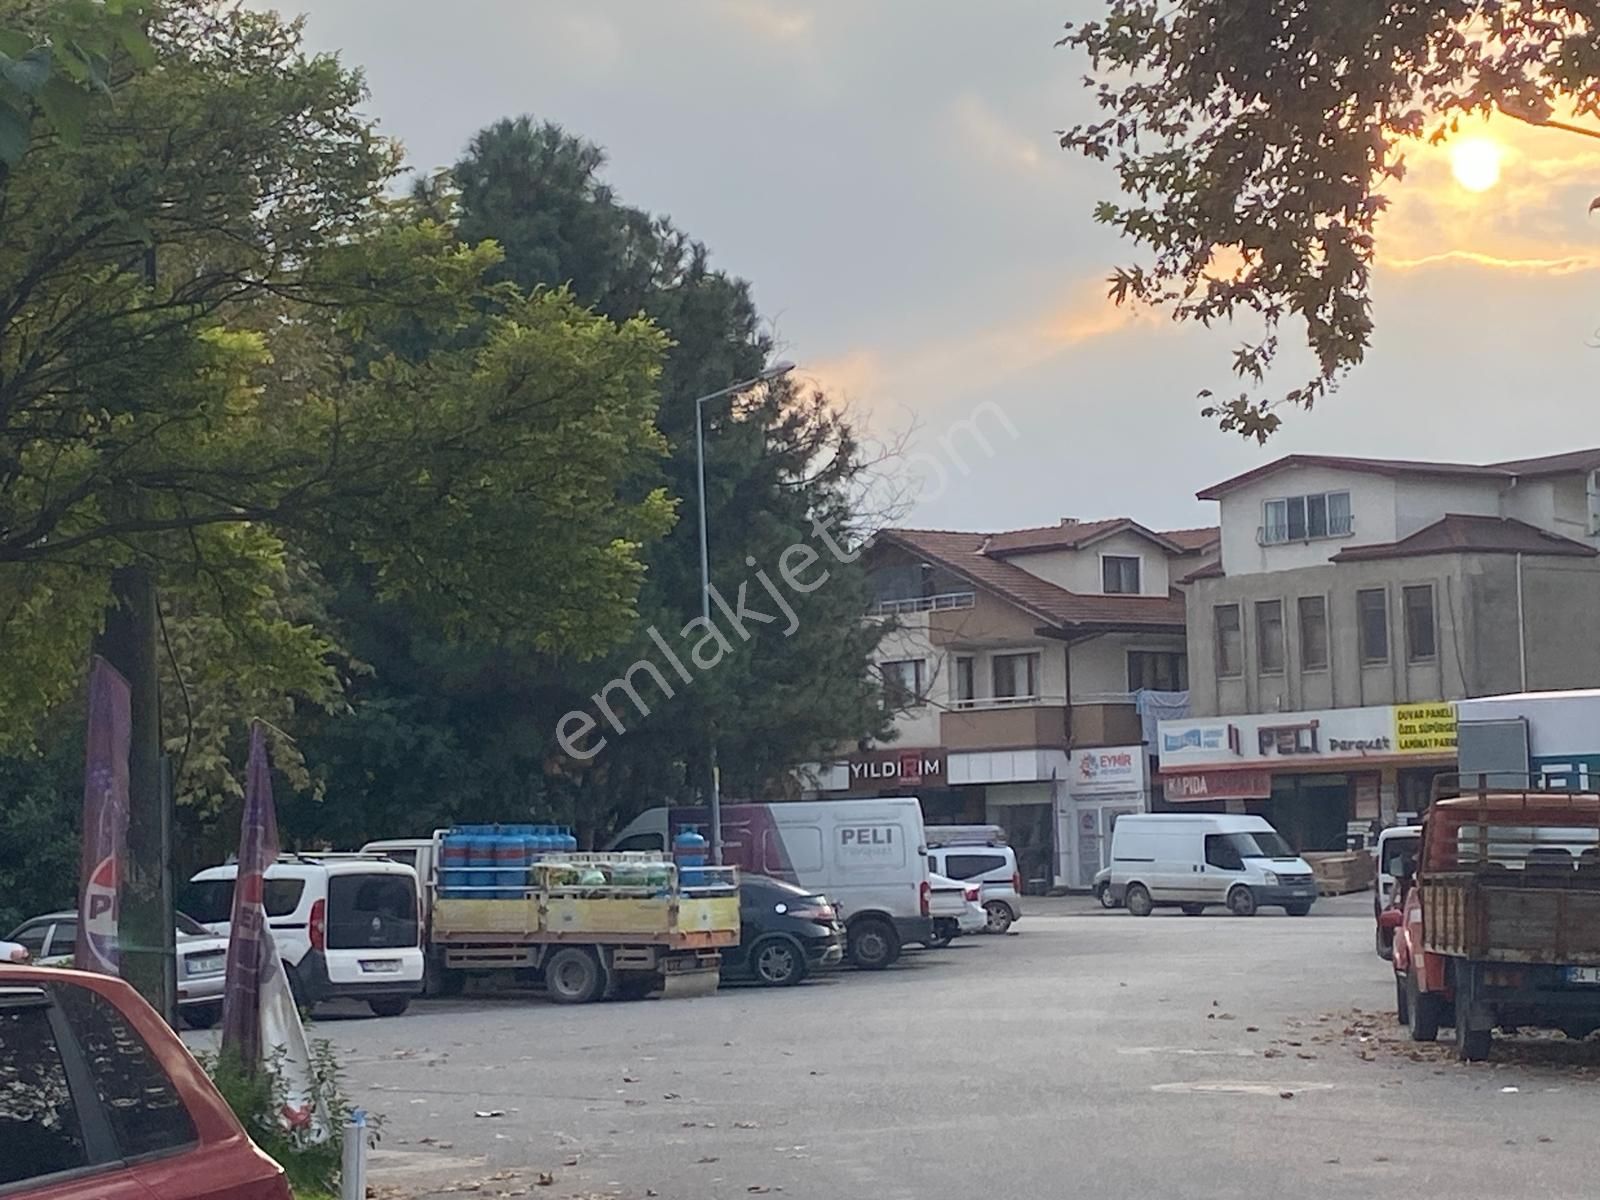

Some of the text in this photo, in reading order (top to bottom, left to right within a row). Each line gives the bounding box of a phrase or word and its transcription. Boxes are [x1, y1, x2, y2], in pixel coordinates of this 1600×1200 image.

[1398, 710, 1424, 720] DUVAR
[1399, 721, 1457, 735] ÖZEL SÜPÜRGE
[1434, 737, 1458, 748] PARK
[851, 758, 940, 779] YILDIRIM
[1167, 776, 1208, 796] KAPIDA
[842, 828, 892, 845] PELI
